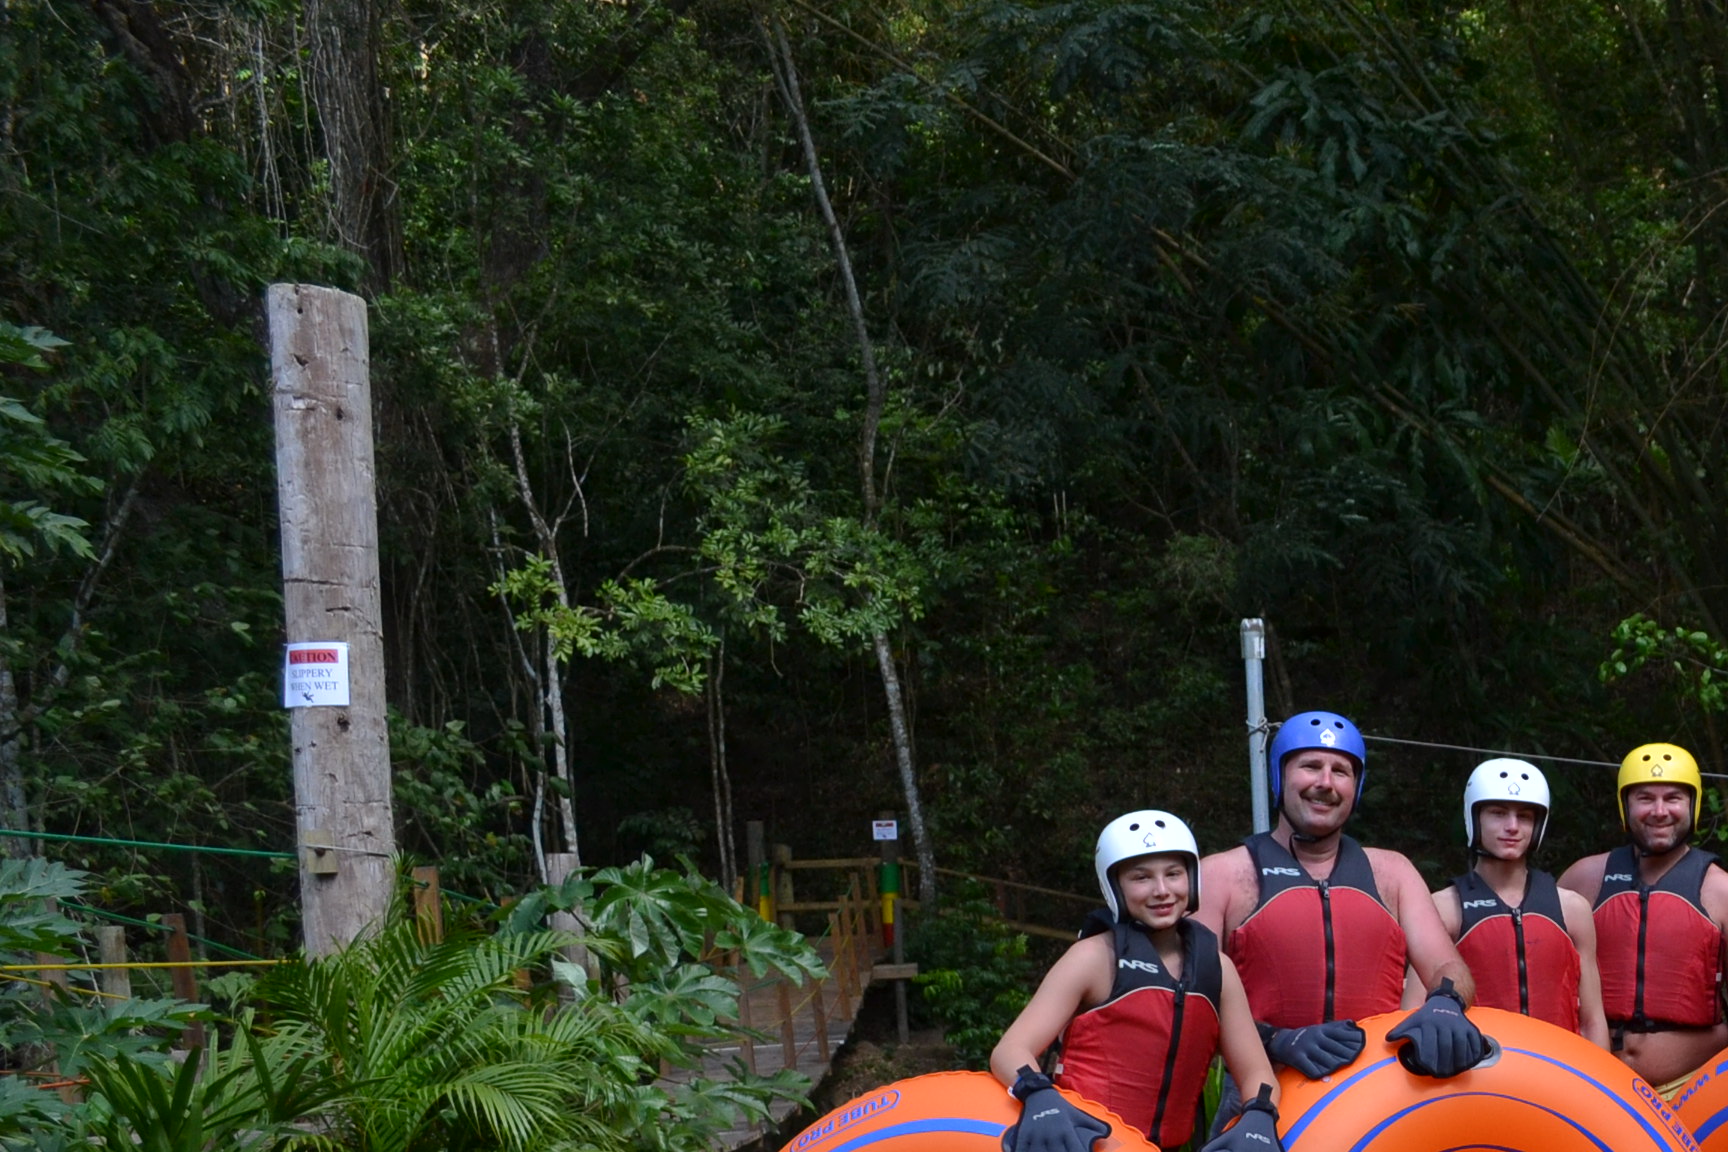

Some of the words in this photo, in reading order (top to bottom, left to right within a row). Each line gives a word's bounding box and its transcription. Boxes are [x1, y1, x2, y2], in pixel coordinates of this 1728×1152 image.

[291, 669, 332, 679] SLIPPERY
[290, 681, 312, 691] WHEN
[314, 681, 339, 690] WET
[1262, 866, 1301, 876] NRS
[1604, 873, 1633, 882] NRS
[1463, 899, 1498, 909] NRS
[1118, 958, 1159, 974] NRS
[1641, 1086, 1671, 1121] PRO
[839, 1096, 891, 1127] TUBE
[1033, 1108, 1060, 1121] NRS
[799, 1120, 834, 1148] PRO
[1245, 1132, 1271, 1145] NRS
